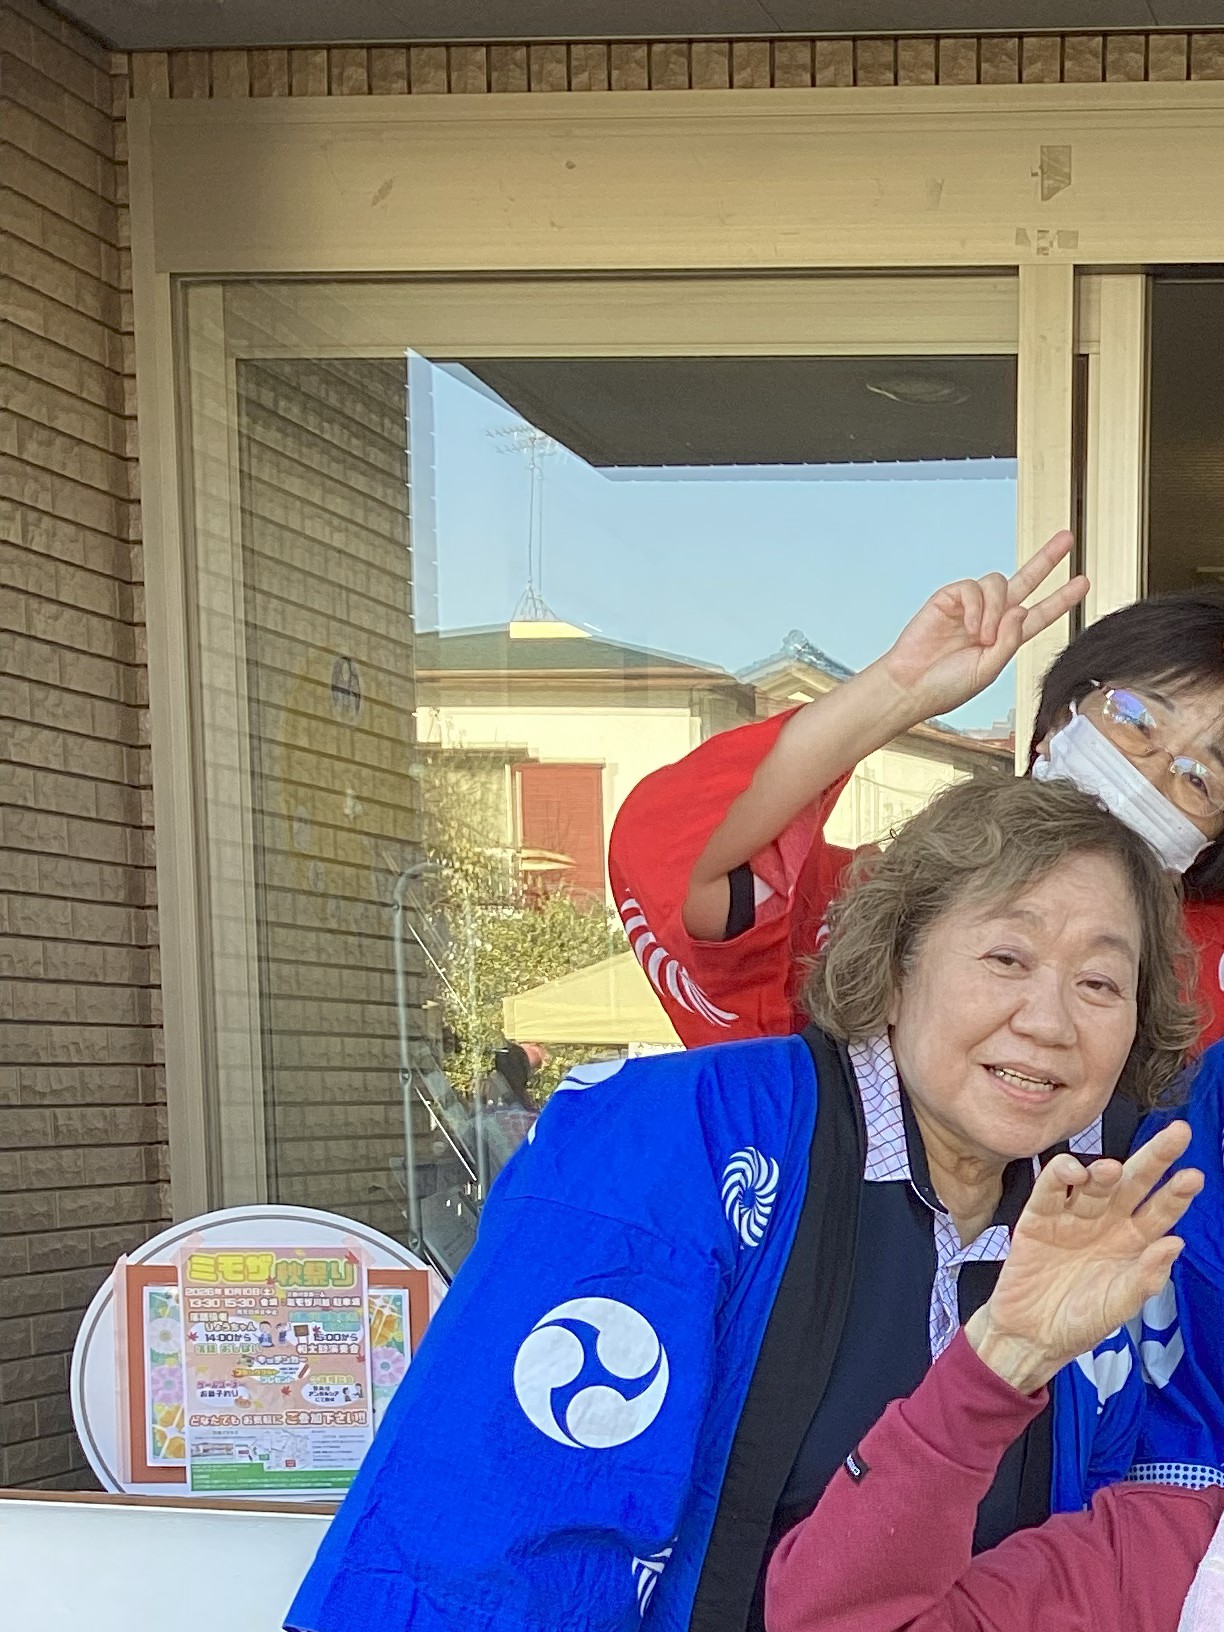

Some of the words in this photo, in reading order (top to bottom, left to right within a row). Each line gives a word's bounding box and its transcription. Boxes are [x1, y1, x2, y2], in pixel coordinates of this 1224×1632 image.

[189, 1254, 274, 1282] ミモザ
[276, 1260, 355, 1287] 秋祭り
[205, 1333, 251, 1342] 14:00から
